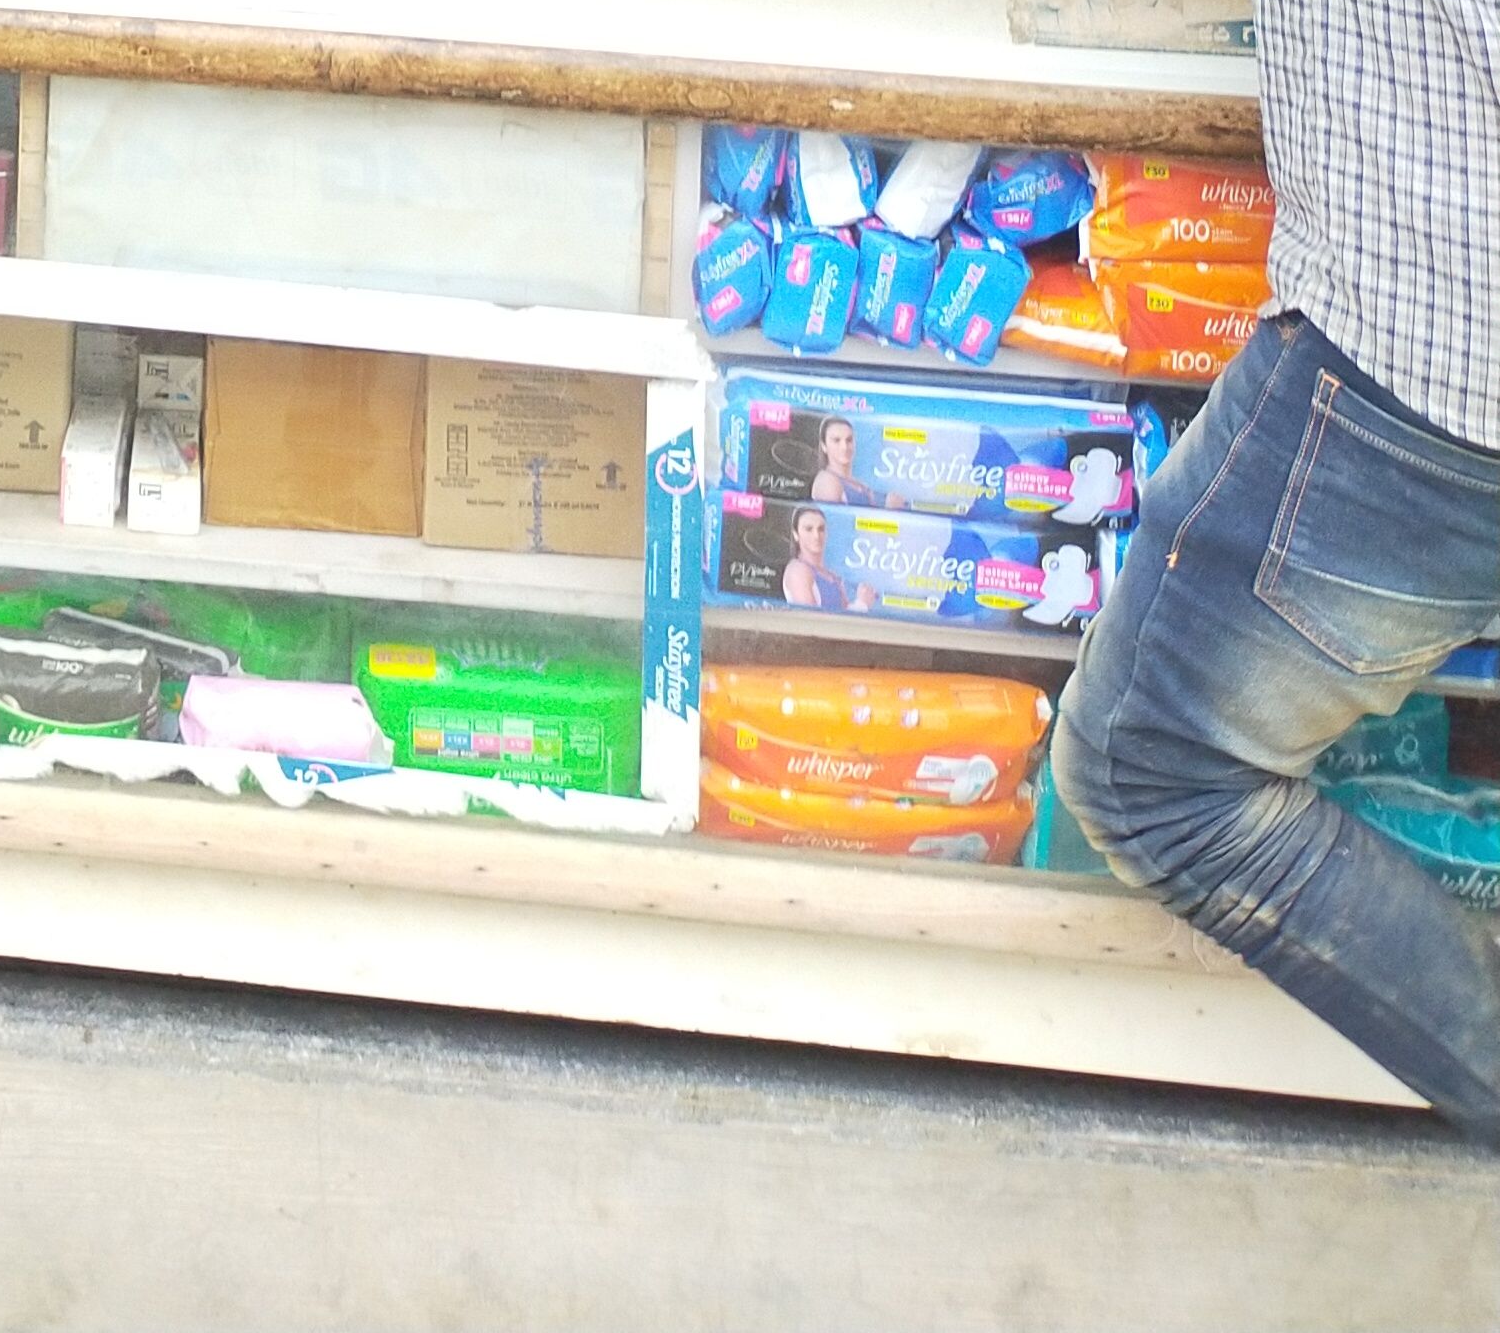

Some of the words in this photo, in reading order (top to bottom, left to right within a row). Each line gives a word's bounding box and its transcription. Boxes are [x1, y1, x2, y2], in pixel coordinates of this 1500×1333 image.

[1200, 176, 1276, 209] whispe
[1203, 310, 1257, 340] whis
[873, 446, 1004, 487] Stayfree
[844, 538, 975, 581] Stayfree
[662, 624, 692, 713] Stayfree
[786, 753, 878, 781] whisper
